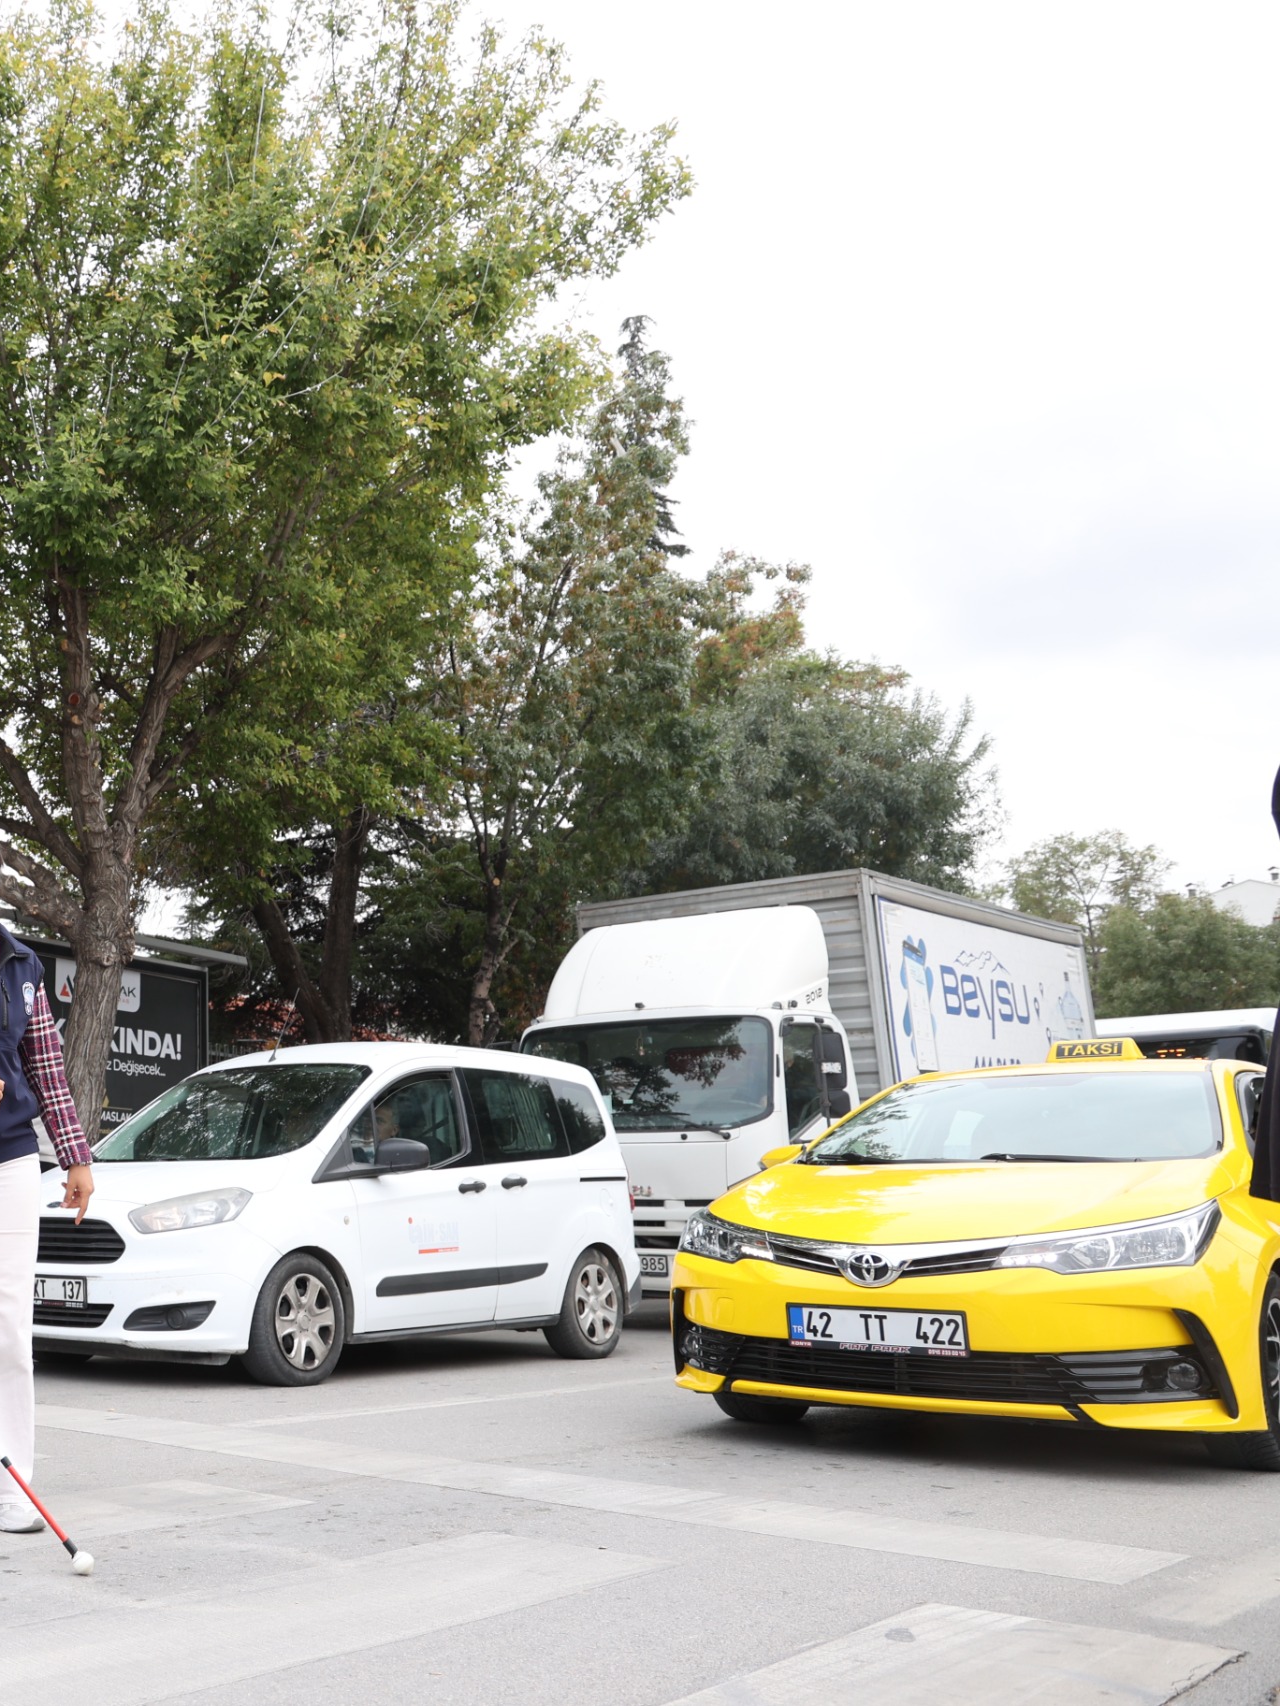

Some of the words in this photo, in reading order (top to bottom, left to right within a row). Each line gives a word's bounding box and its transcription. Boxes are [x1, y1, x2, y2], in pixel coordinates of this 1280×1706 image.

[111, 1027, 181, 1060] KINDA!
[641, 1257, 665, 1271] 985
[62, 1280, 81, 1300] 137
[792, 1325, 804, 1334] TR
[806, 1311, 833, 1338] 42
[859, 1313, 887, 1341] TT
[915, 1317, 962, 1346] 422
